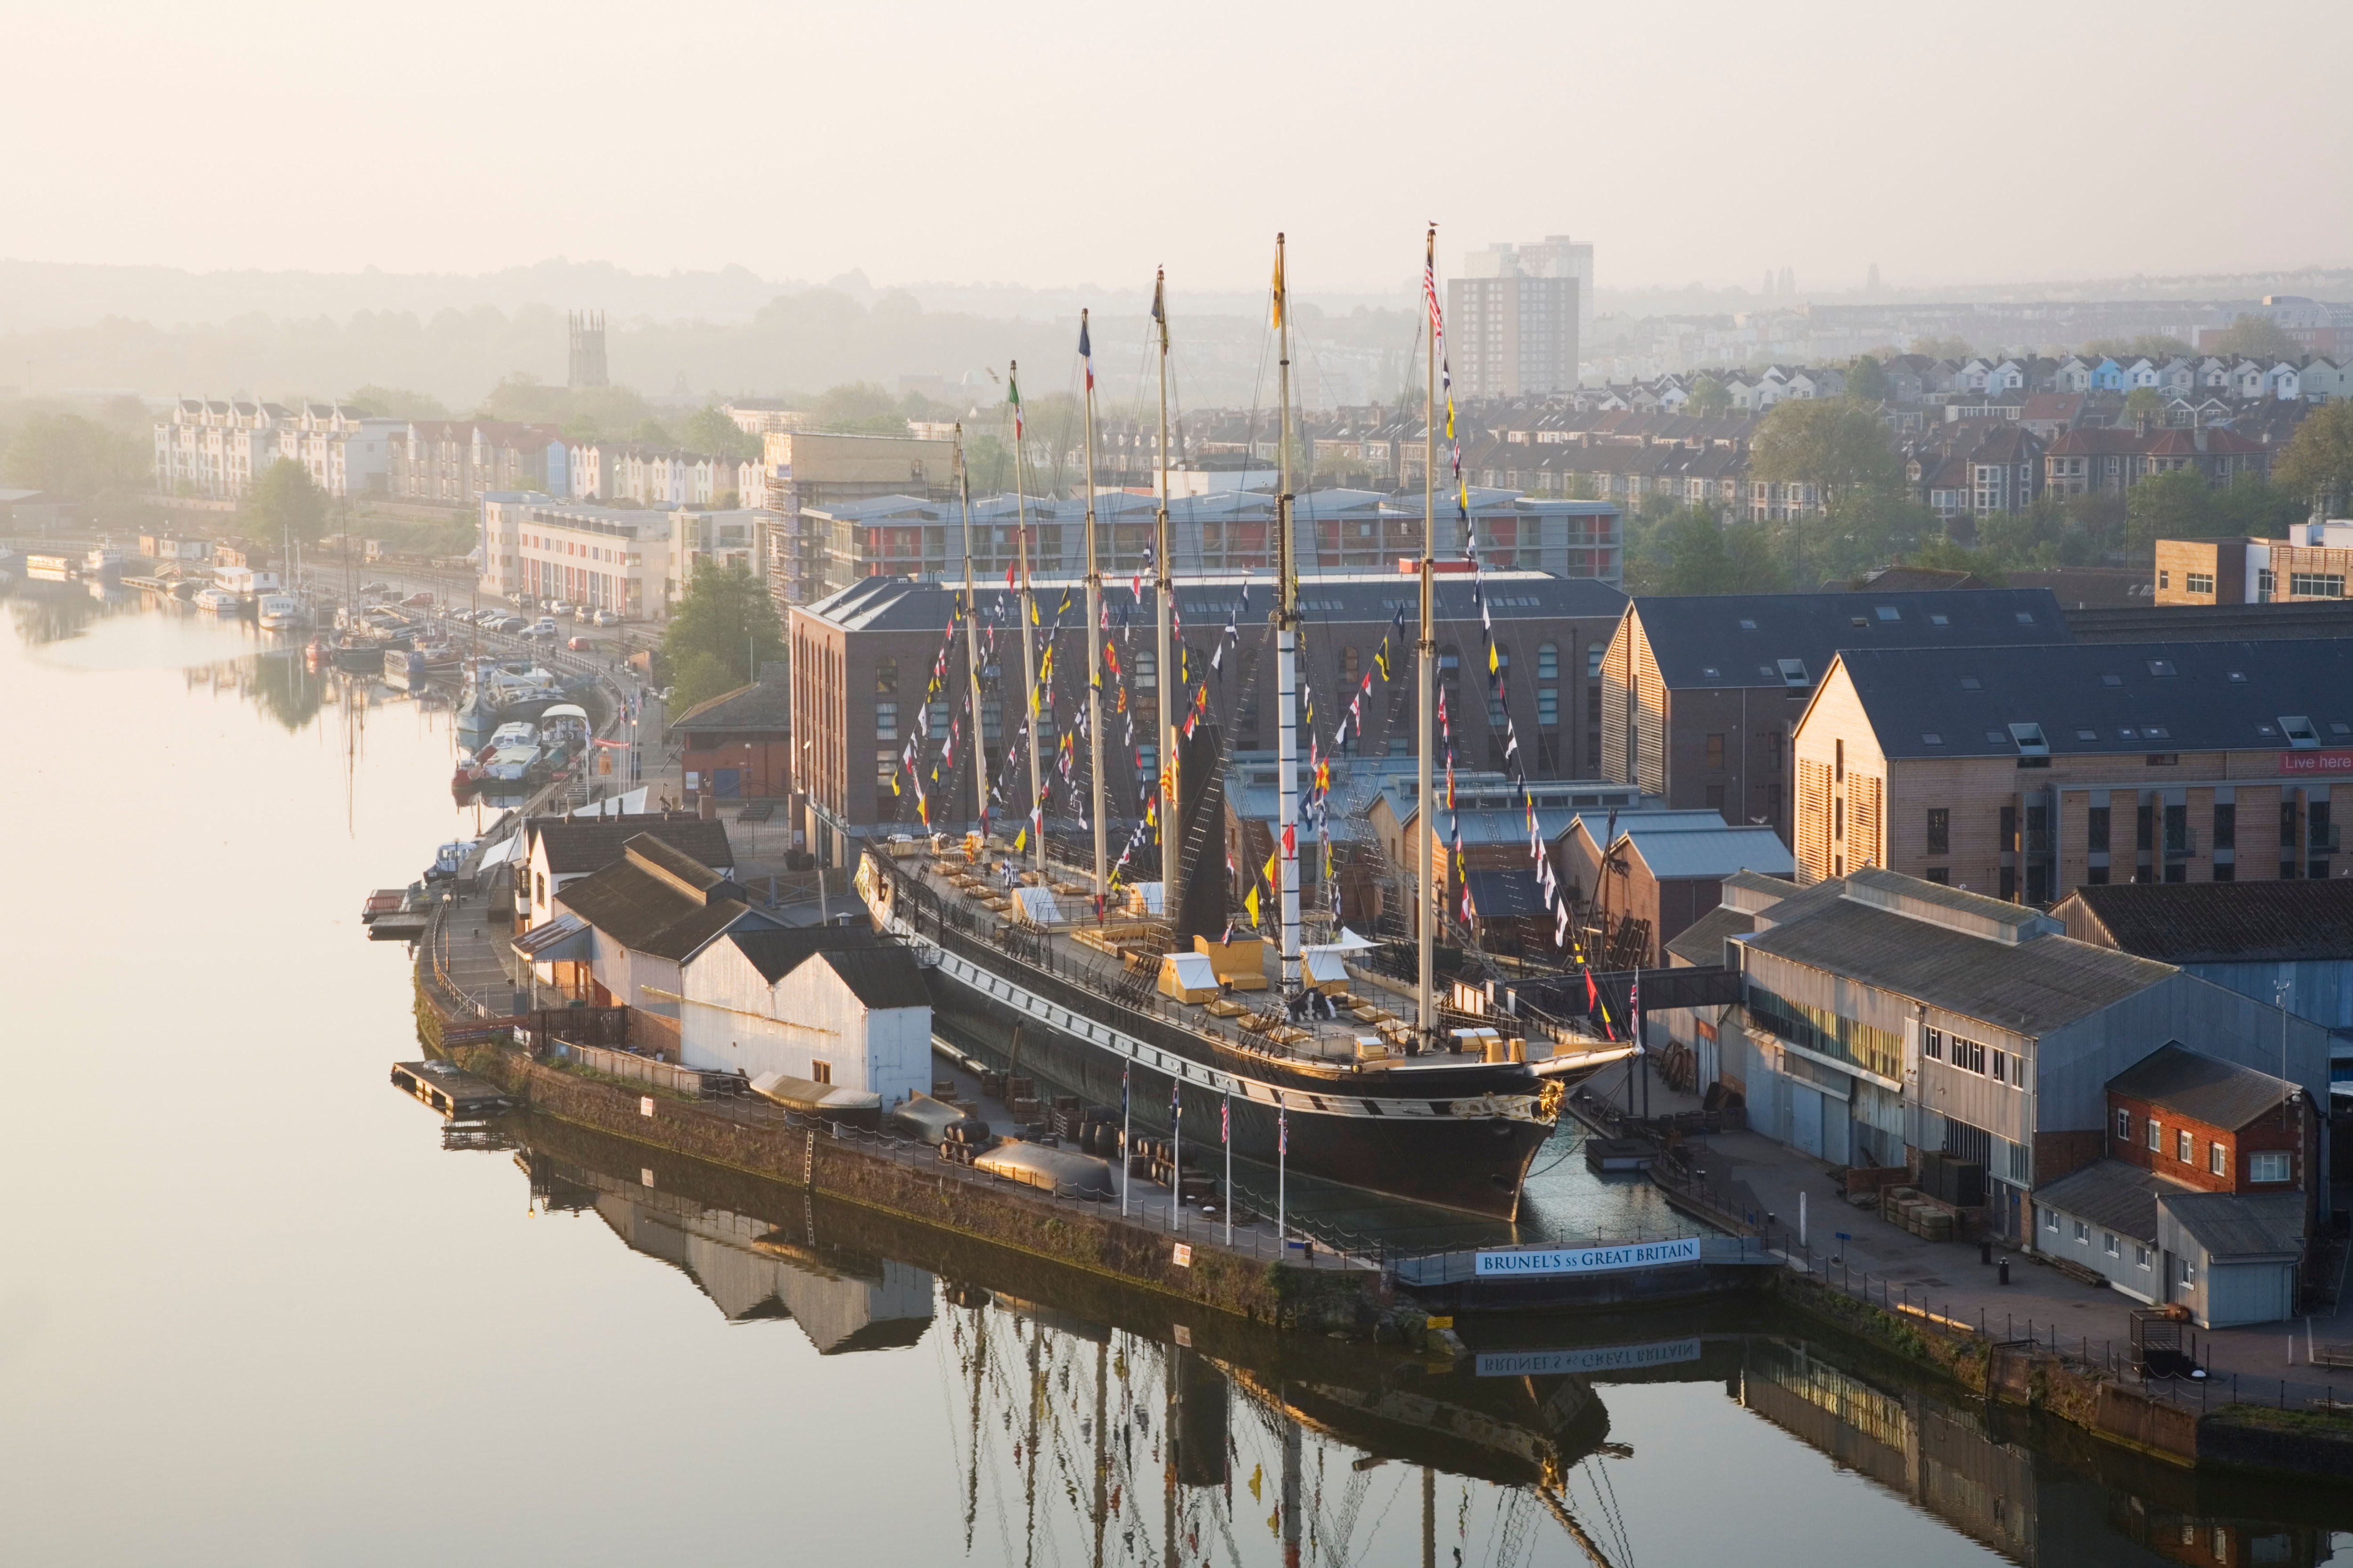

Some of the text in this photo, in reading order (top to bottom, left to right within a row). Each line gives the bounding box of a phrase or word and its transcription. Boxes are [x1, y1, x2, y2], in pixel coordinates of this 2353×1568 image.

[2286, 755, 2351, 768] Live here
[1484, 1255, 1561, 1270] BRUNEL'S
[1582, 1250, 1632, 1266] GREAT
[1637, 1243, 1693, 1262] BRITAIN
